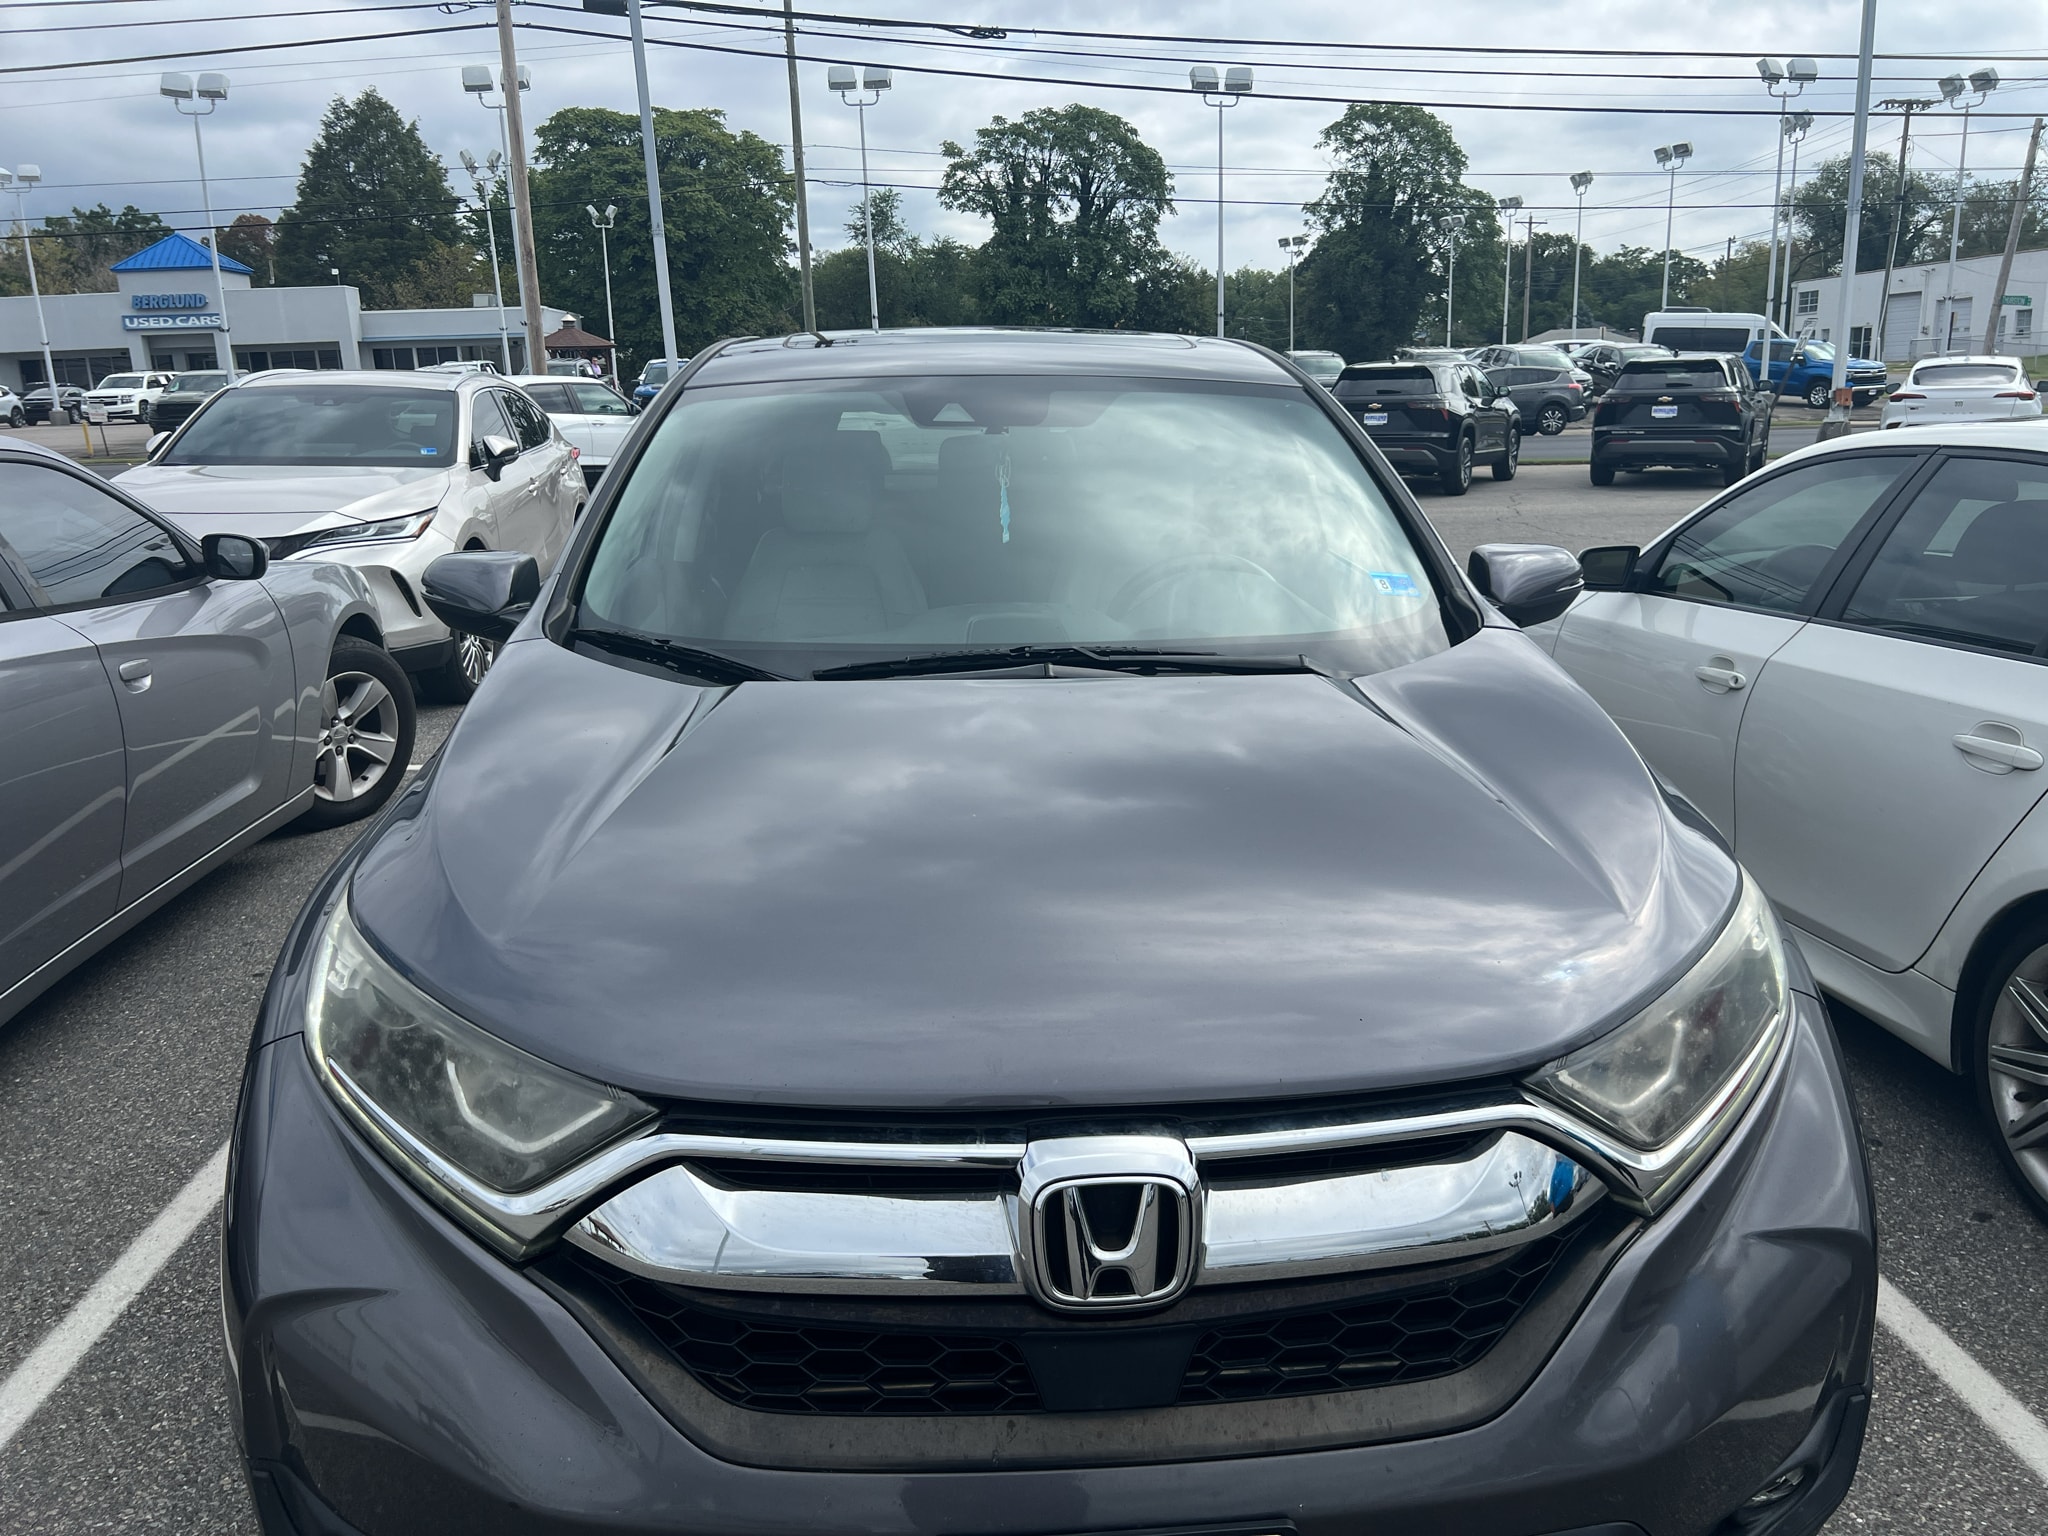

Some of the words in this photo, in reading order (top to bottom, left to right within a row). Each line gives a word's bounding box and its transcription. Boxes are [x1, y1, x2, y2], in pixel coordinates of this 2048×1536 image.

[131, 293, 207, 310] BERGLUND
[125, 317, 173, 327] USED
[175, 315, 221, 326] CARS
